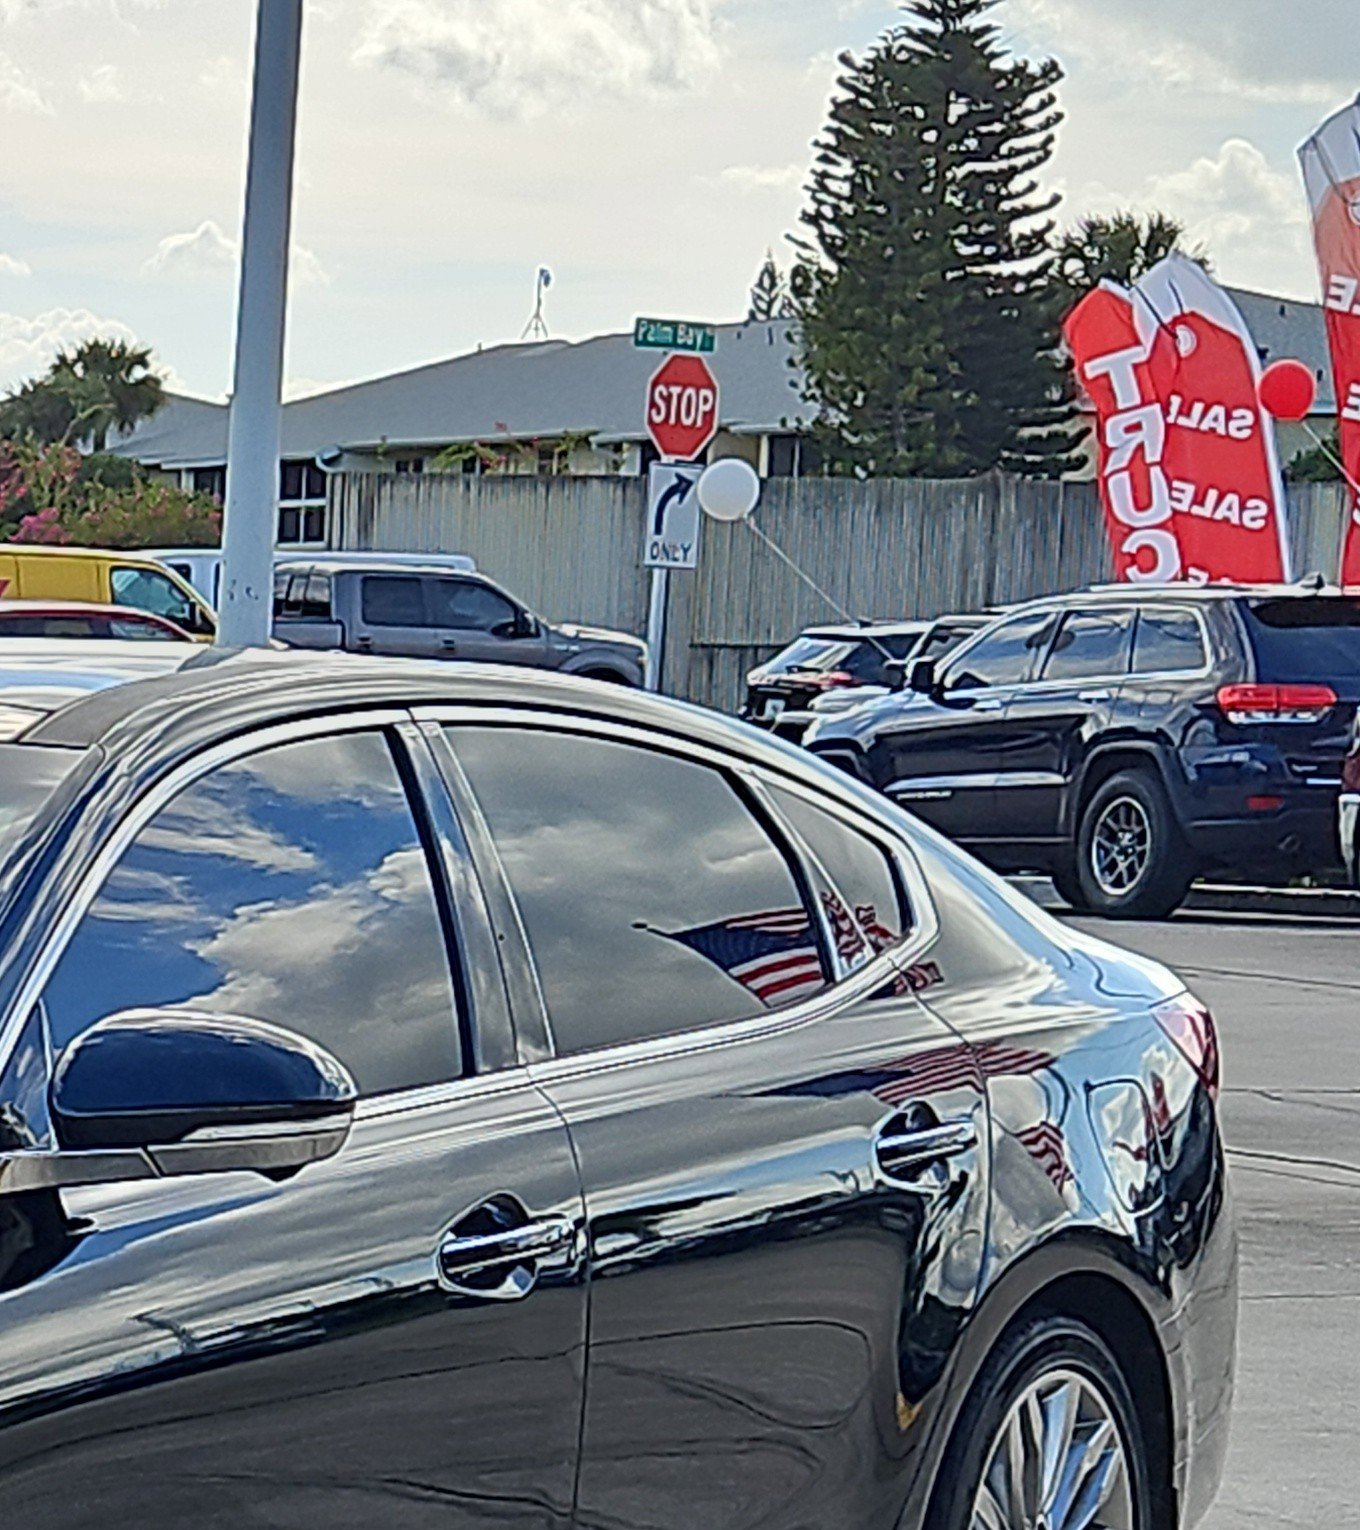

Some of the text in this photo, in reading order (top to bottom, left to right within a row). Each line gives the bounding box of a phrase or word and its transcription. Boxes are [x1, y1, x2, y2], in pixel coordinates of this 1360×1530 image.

[638, 320, 673, 344] Palm
[677, 323, 704, 351] Bay
[650, 383, 714, 428] STOP
[650, 541, 692, 563] ONLY
